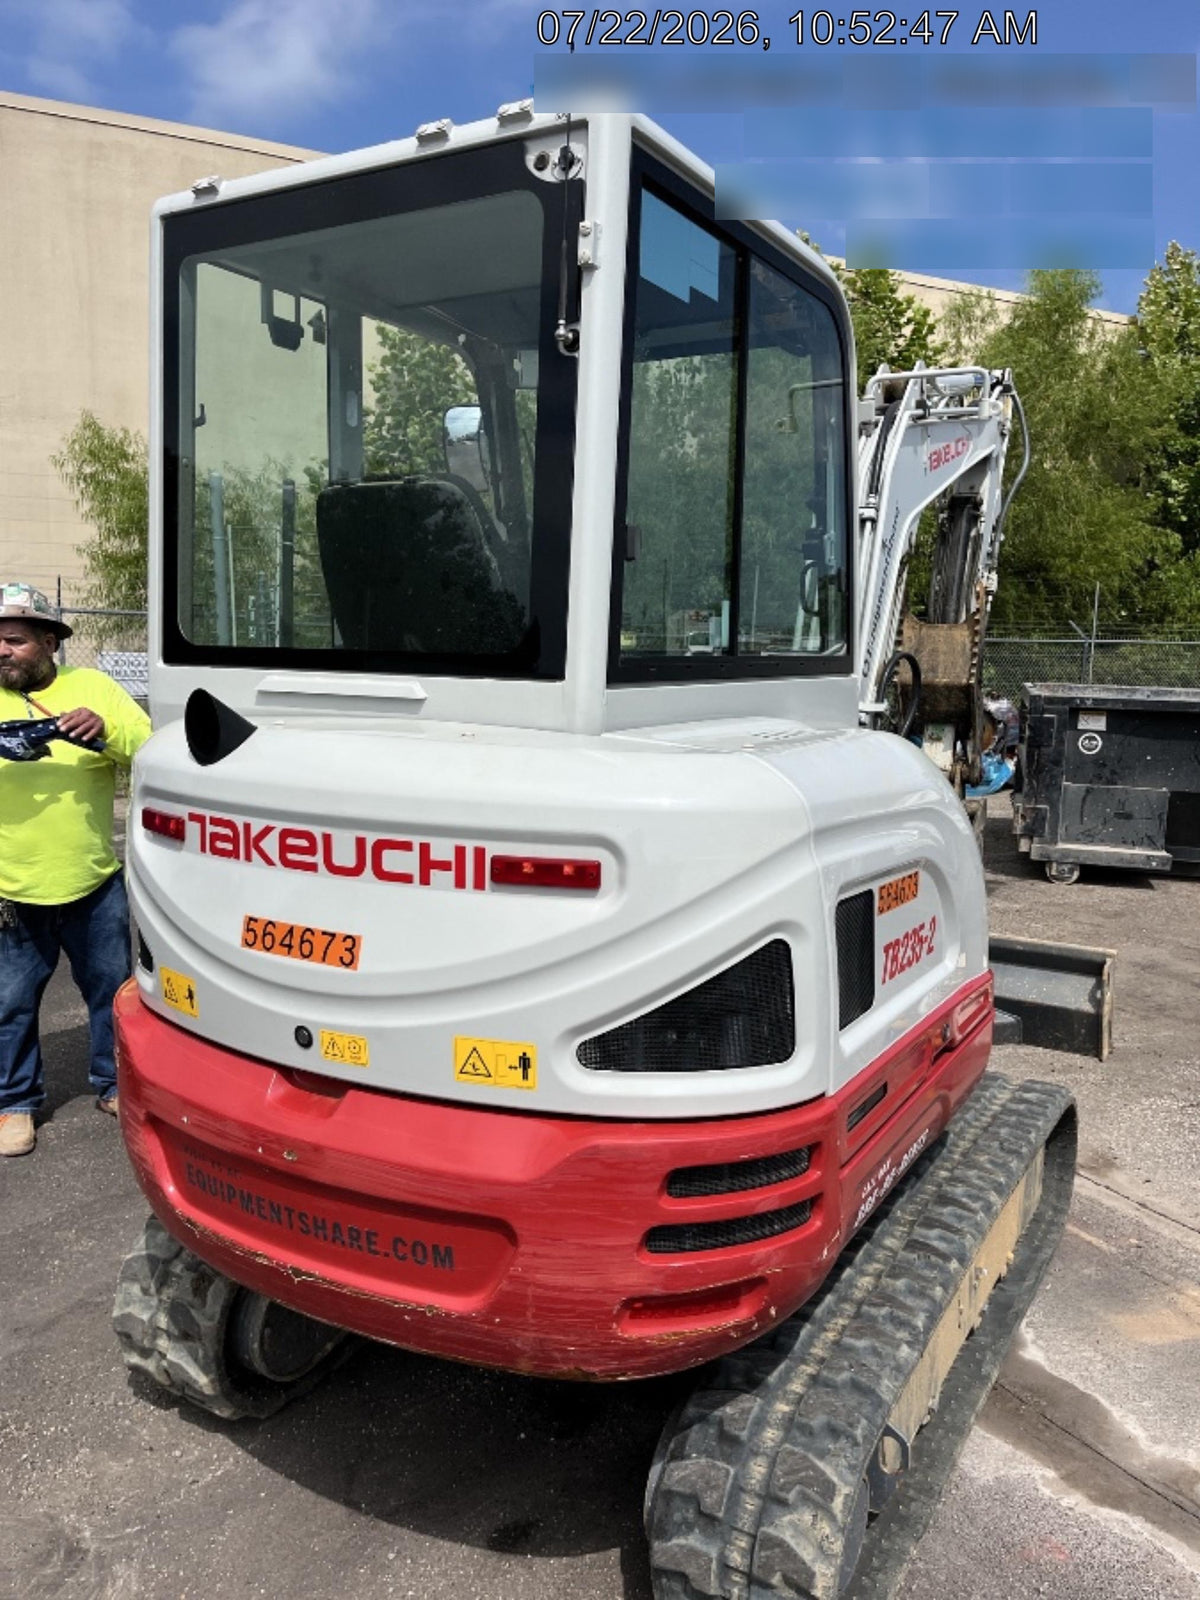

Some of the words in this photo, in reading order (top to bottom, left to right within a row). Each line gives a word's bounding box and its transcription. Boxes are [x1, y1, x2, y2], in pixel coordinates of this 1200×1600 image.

[188, 812, 487, 891] TAKEUCHI
[244, 917, 356, 968] 564673
[184, 1163, 455, 1271] EQUIPMENTSHARE.COM
